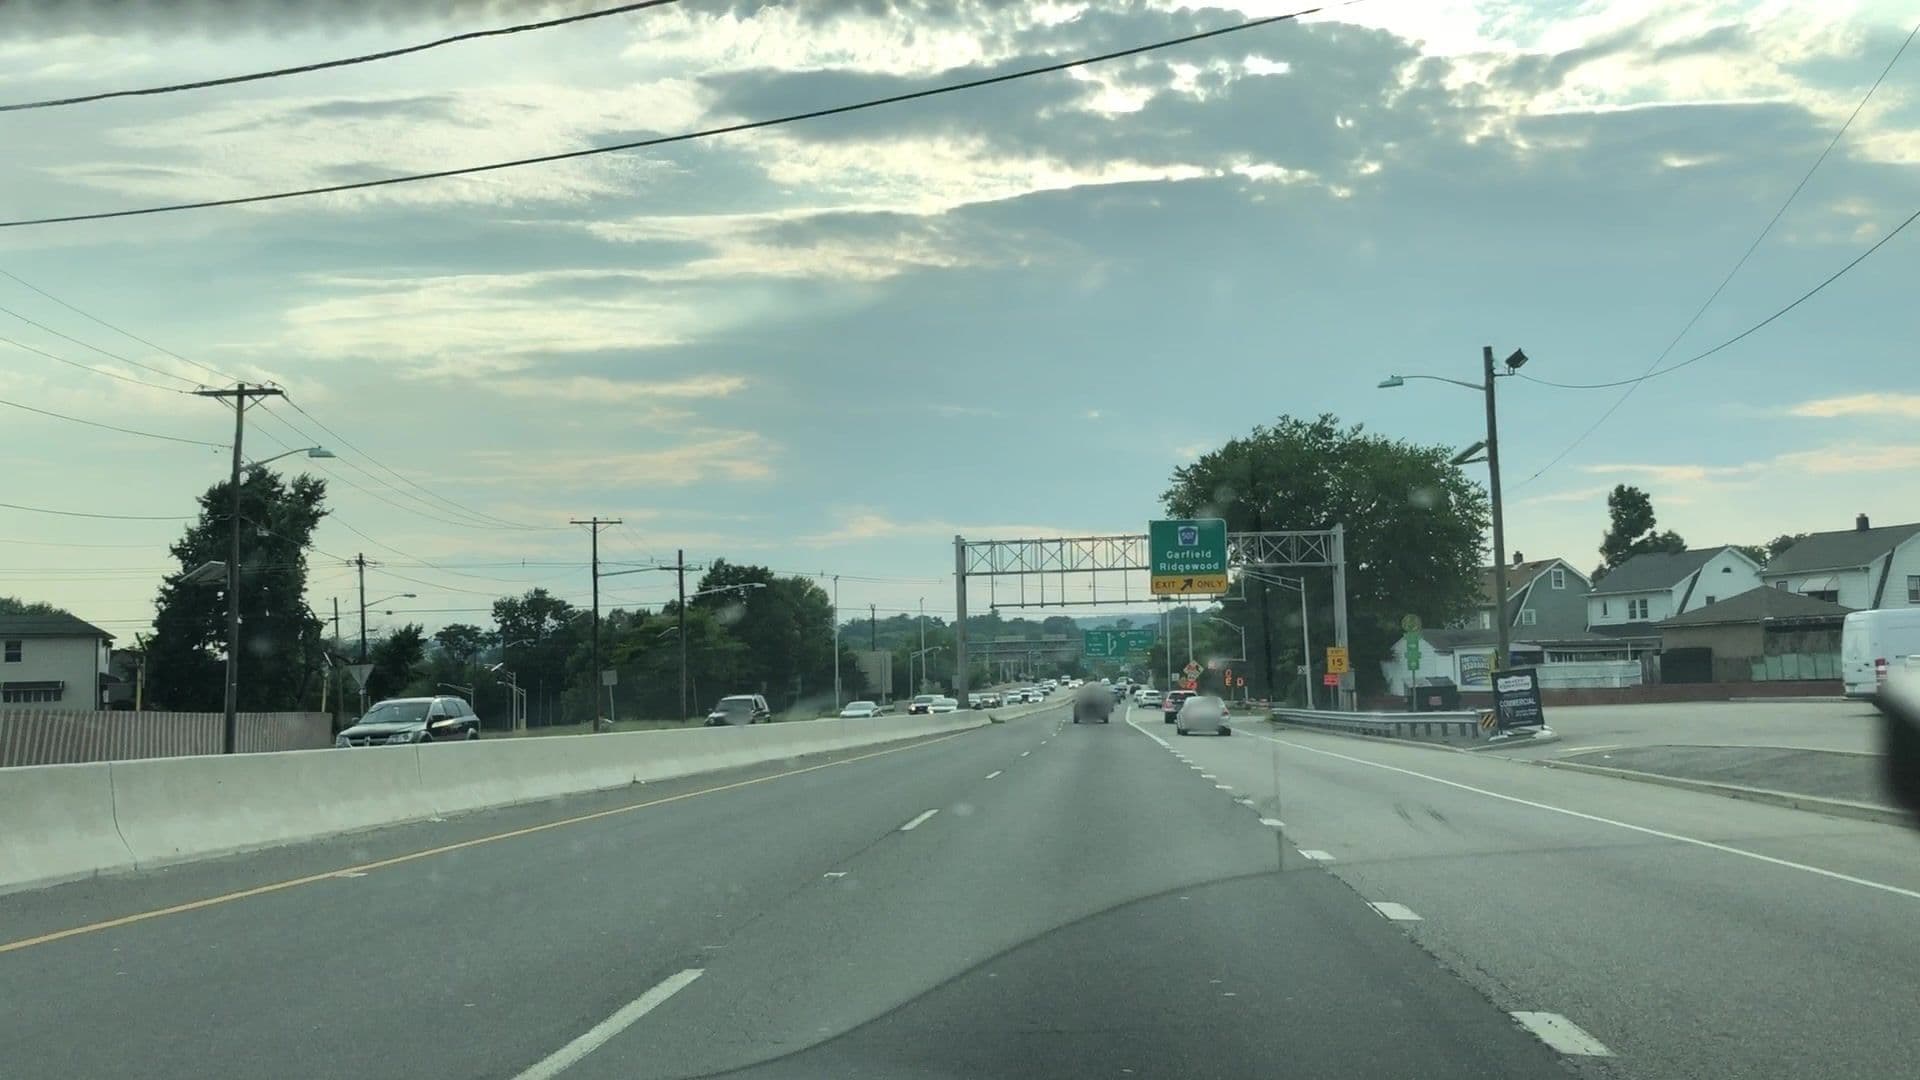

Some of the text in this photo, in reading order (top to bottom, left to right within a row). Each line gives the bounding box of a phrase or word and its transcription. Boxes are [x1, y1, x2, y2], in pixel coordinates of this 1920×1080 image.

[1166, 550, 1212, 559] Garfield
[1160, 562, 1219, 573] Ridgewood
[1155, 580, 1224, 589] EXIT ONLY
[1331, 657, 1344, 667] 15
[1499, 698, 1536, 707] COMMERCIAL
